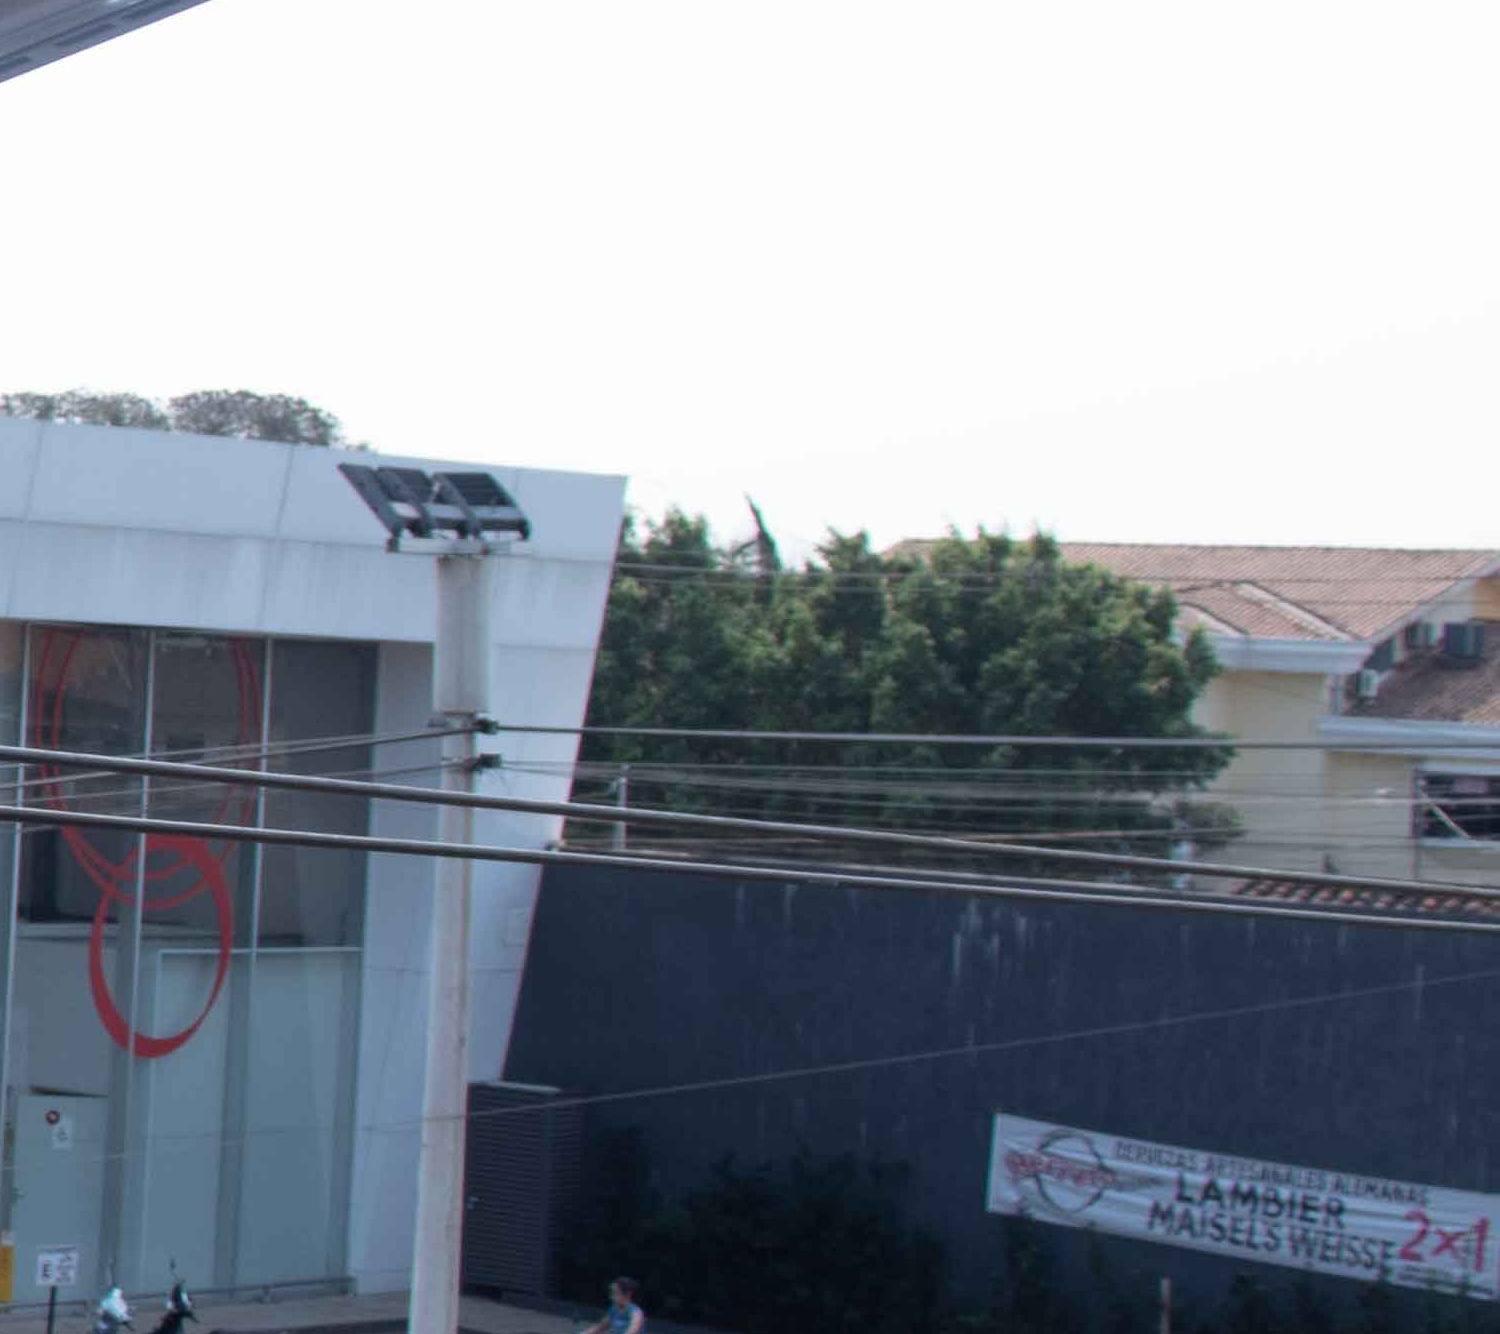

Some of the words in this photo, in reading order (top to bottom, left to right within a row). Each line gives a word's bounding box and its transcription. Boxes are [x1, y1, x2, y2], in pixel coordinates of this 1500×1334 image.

[1147, 1199, 1281, 1252] MAISELS
[1174, 1171, 1346, 1229] LAMBIER
[1398, 1209, 1489, 1274] 2x1
